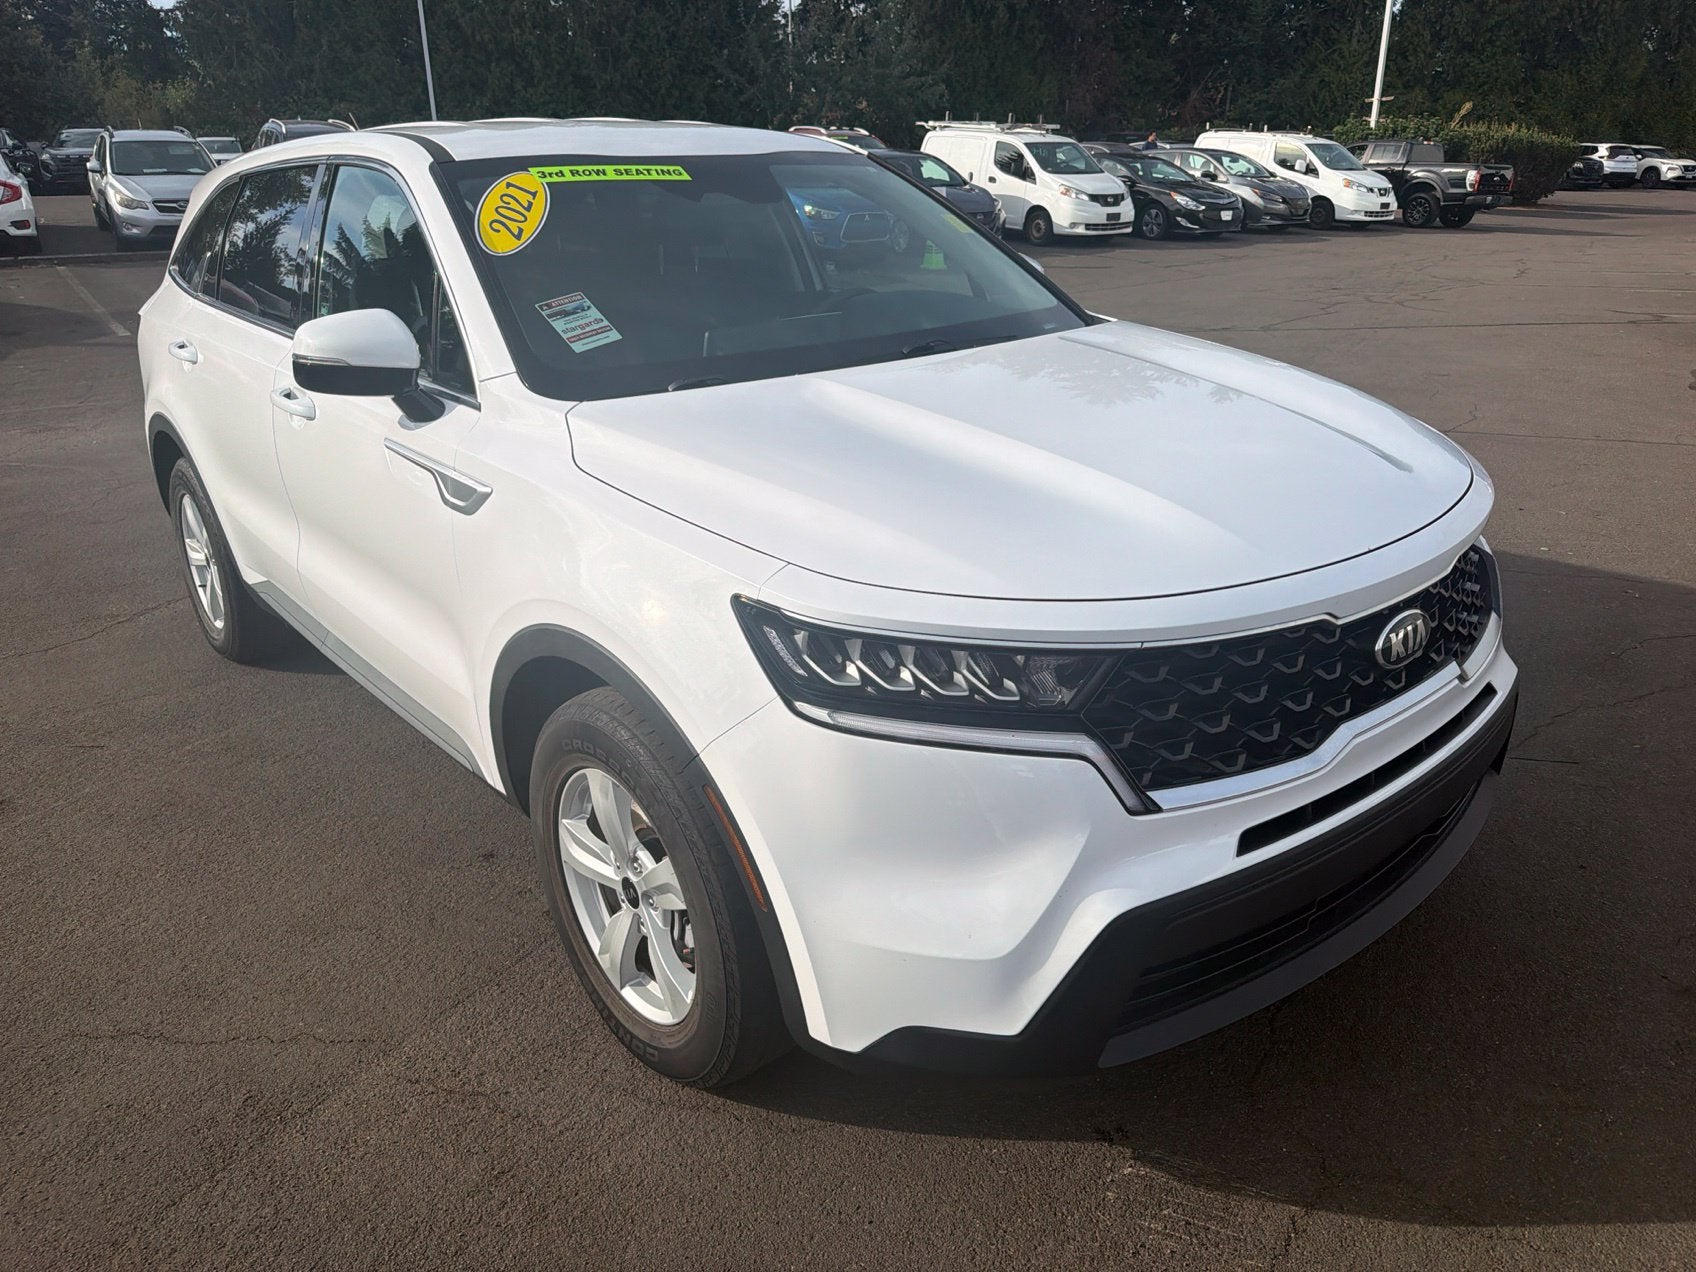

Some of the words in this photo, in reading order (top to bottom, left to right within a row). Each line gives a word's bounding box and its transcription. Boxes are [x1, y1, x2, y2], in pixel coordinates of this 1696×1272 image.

[537, 169, 566, 179] 3rd
[569, 168, 607, 177] ROW
[612, 167, 683, 177] SEATING
[489, 181, 538, 241] 2021
